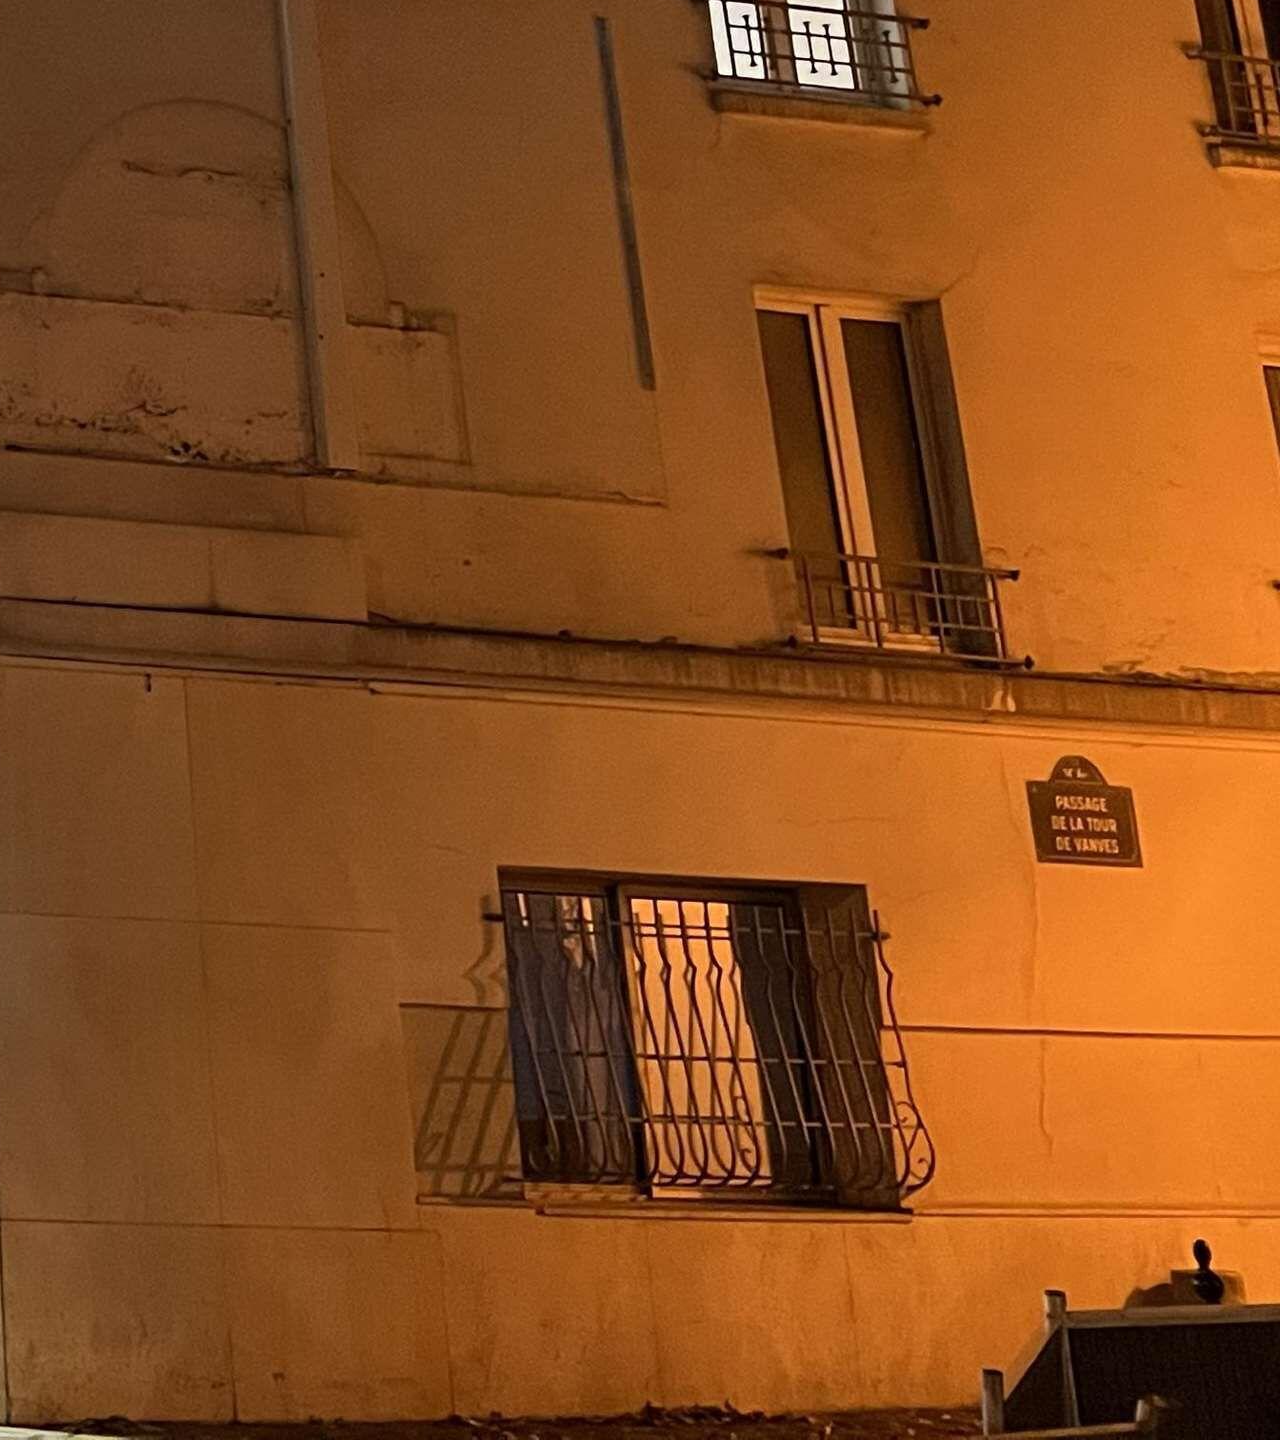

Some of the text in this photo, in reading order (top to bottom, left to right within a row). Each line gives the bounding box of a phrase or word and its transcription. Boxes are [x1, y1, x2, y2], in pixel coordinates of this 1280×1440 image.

[1055, 795, 1109, 812] PASSAGE
[1051, 815, 1117, 833] DE LA TOUR
[1055, 836, 1119, 854] DE VANVES
